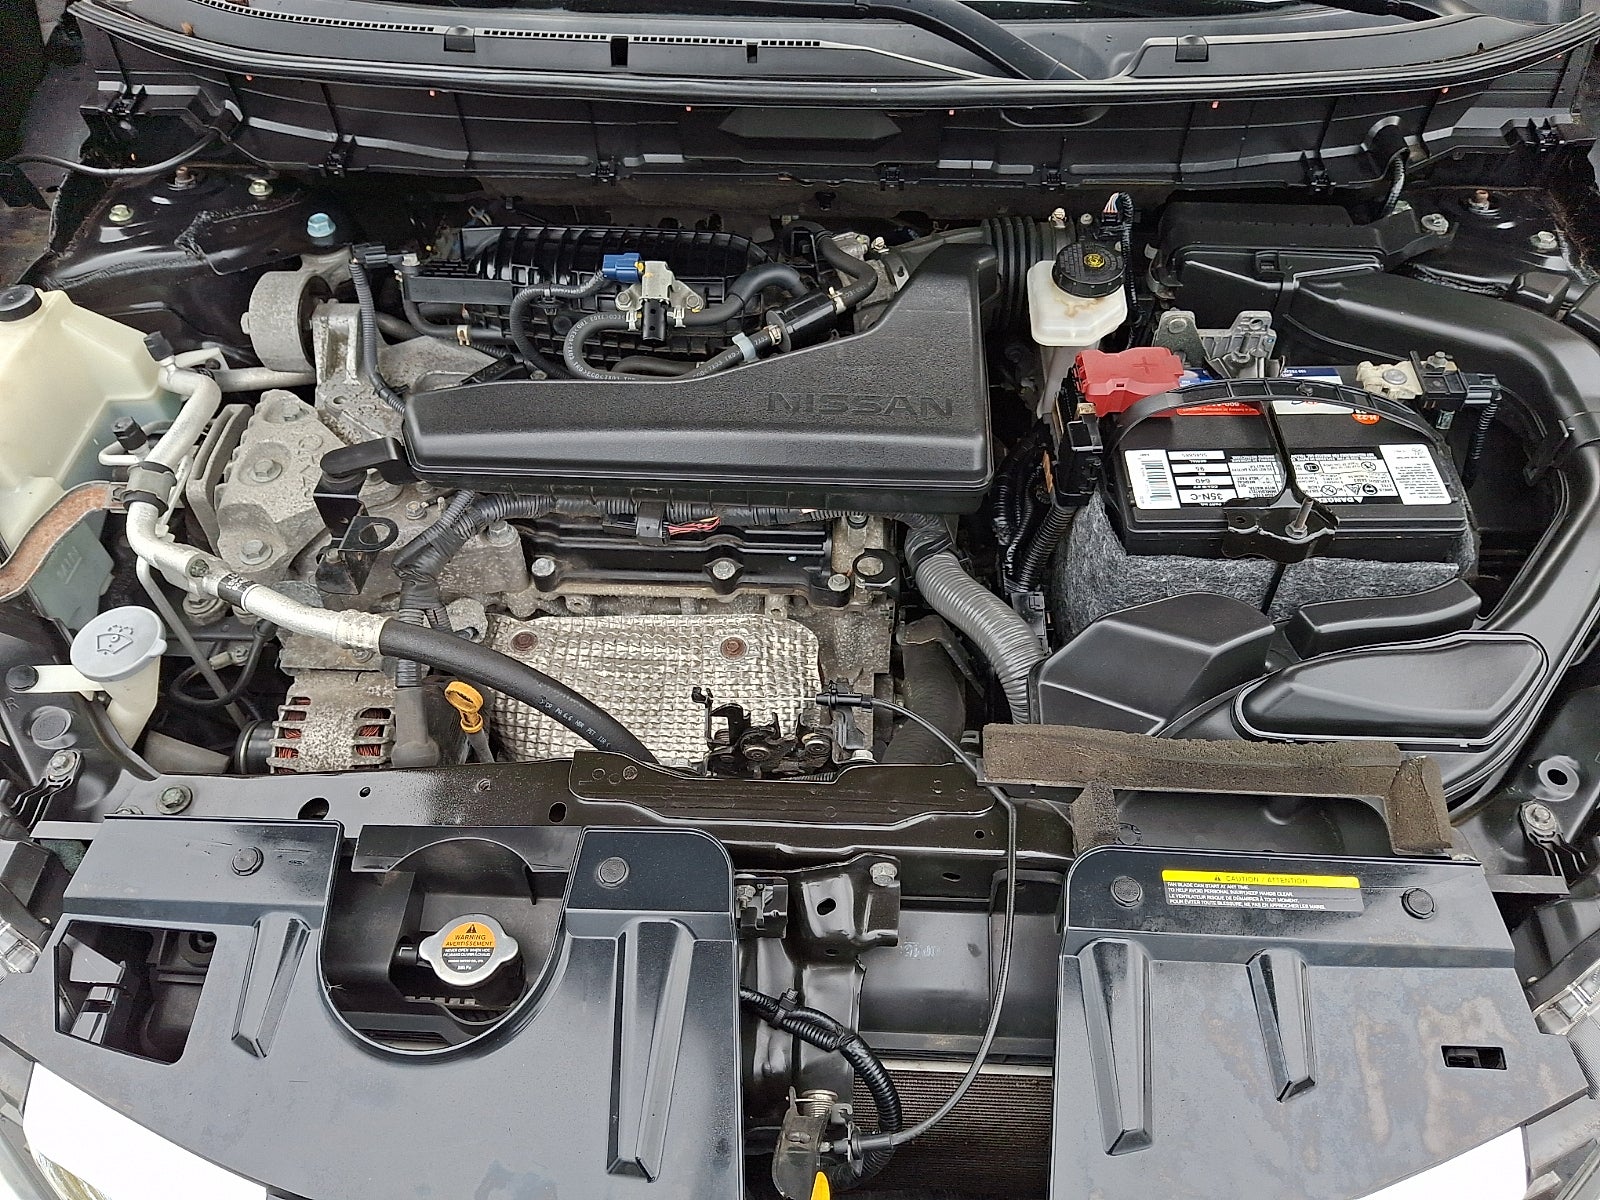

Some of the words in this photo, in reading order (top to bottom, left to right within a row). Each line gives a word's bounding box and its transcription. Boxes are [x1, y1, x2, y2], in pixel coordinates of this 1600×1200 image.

[766, 392, 953, 417] NISSAN
[1190, 492, 1224, 501] 35N-C
[1226, 875, 1259, 883] CAUTION
